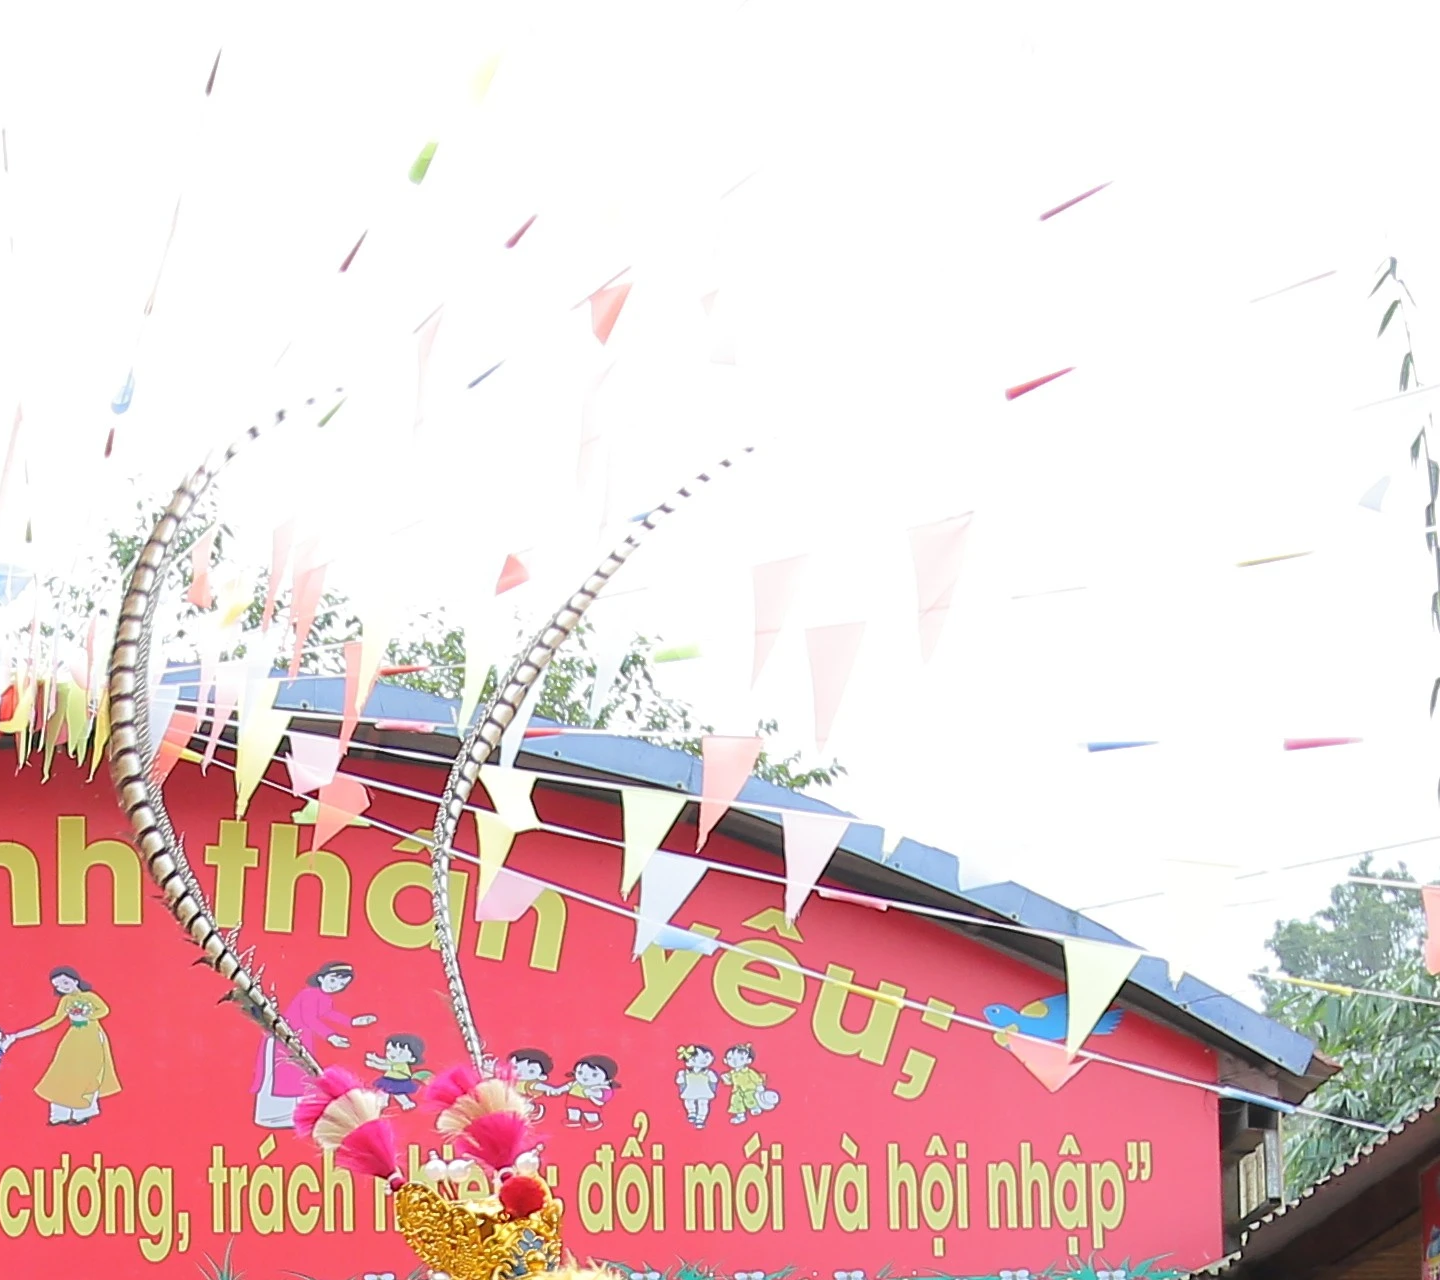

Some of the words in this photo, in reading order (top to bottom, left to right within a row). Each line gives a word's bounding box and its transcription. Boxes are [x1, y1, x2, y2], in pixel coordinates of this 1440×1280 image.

[203, 816, 569, 974] thân
[208, 1134, 355, 1235] trách
[577, 1110, 665, 1235] đổi
[683, 1132, 785, 1233] mới
[801, 1132, 870, 1233] và
[887, 1133, 969, 1258] hội
[986, 1133, 1153, 1258] nhập”
